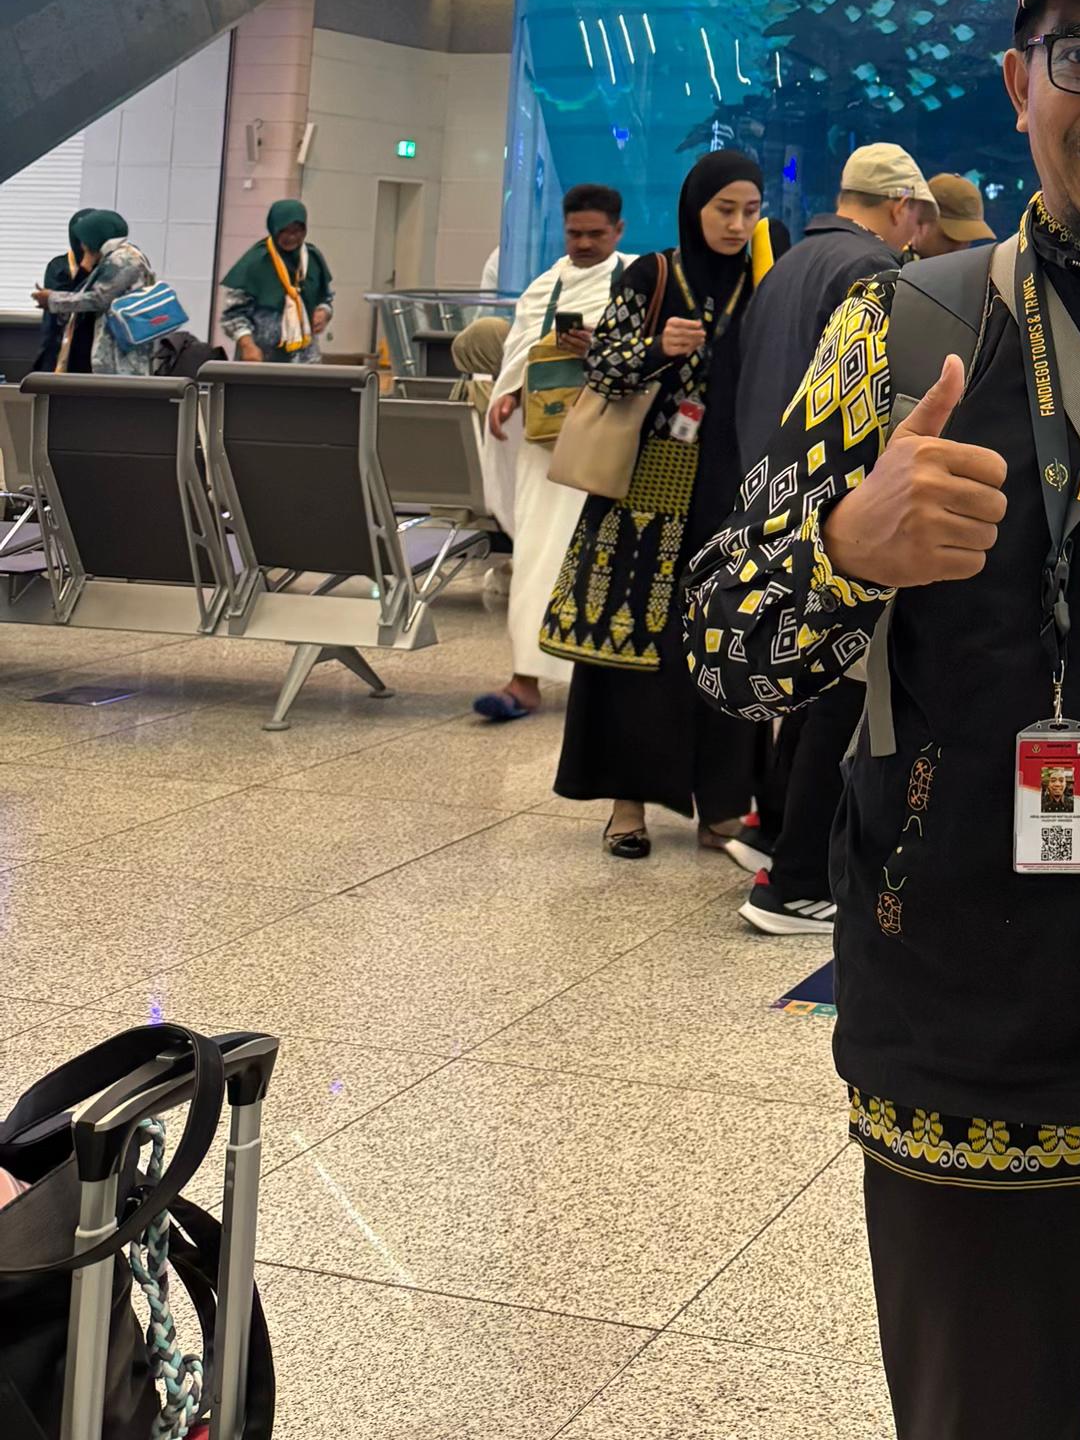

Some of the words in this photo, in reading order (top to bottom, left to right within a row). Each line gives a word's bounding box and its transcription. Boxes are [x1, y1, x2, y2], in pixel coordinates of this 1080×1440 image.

[1022, 272, 1040, 315] TRAVEL
[1027, 313, 1042, 324] &
[1028, 323, 1047, 361] TOURS
[1033, 360, 1056, 418] FANDIEGO
